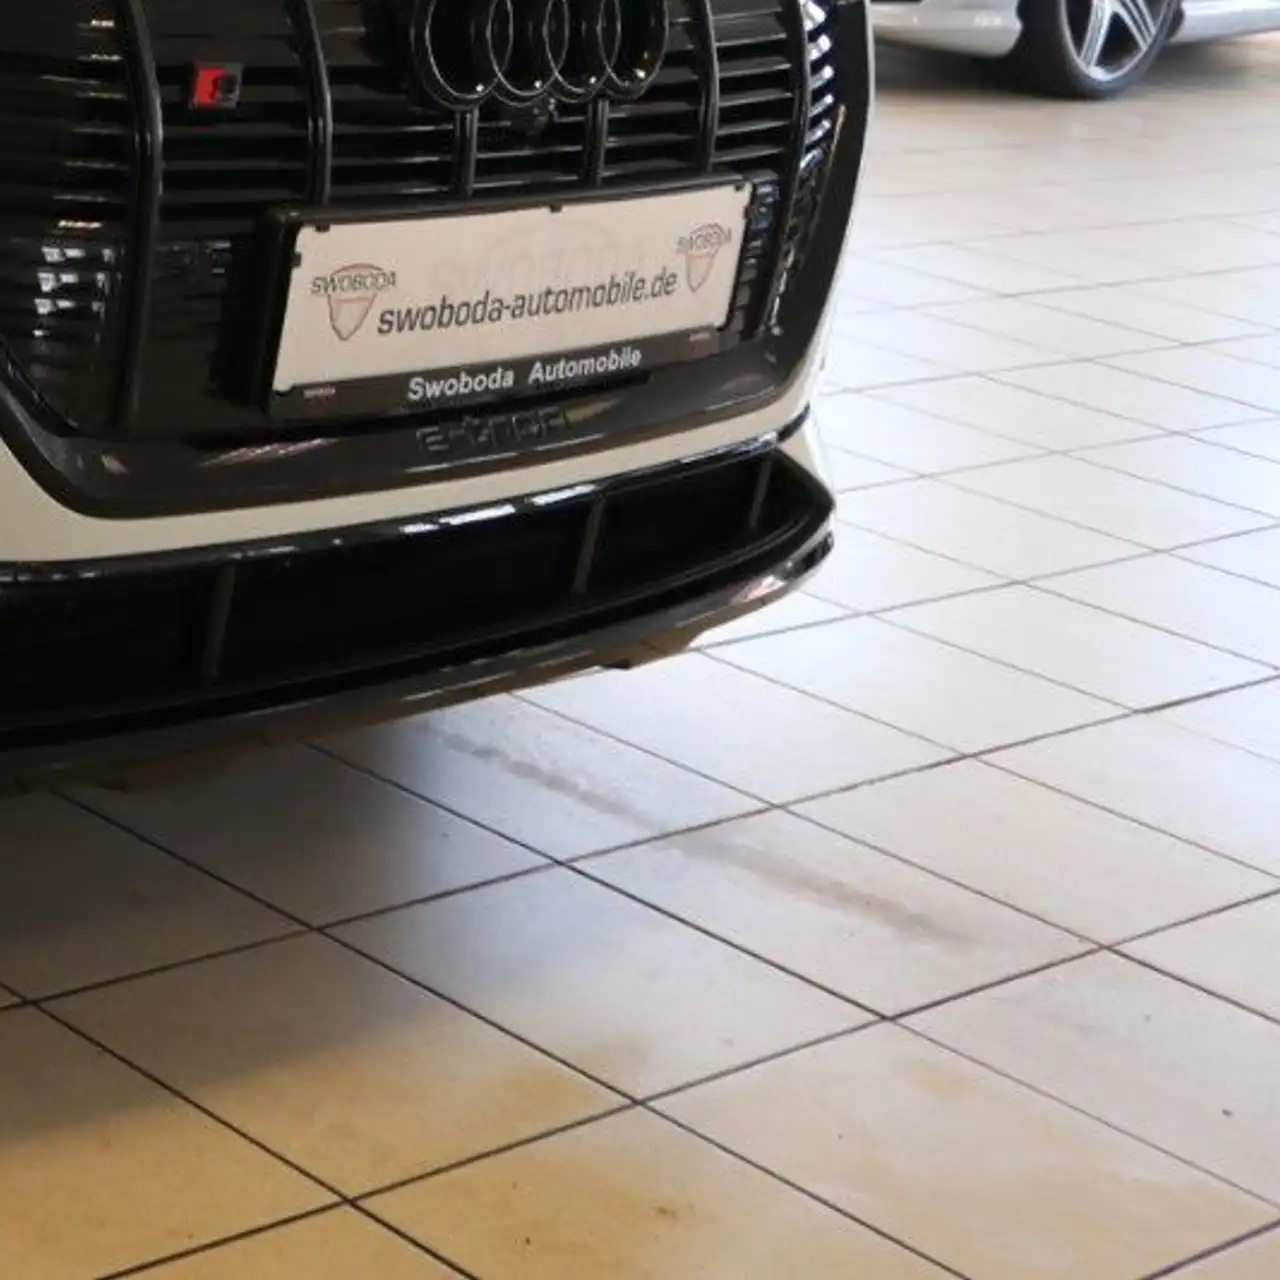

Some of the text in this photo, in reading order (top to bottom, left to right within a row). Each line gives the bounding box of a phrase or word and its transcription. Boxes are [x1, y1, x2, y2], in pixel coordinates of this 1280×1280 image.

[310, 272, 397, 295] SWOBODA
[376, 265, 678, 336] swoboda-automobile.de
[408, 347, 642, 402] Swoboda Automobile
